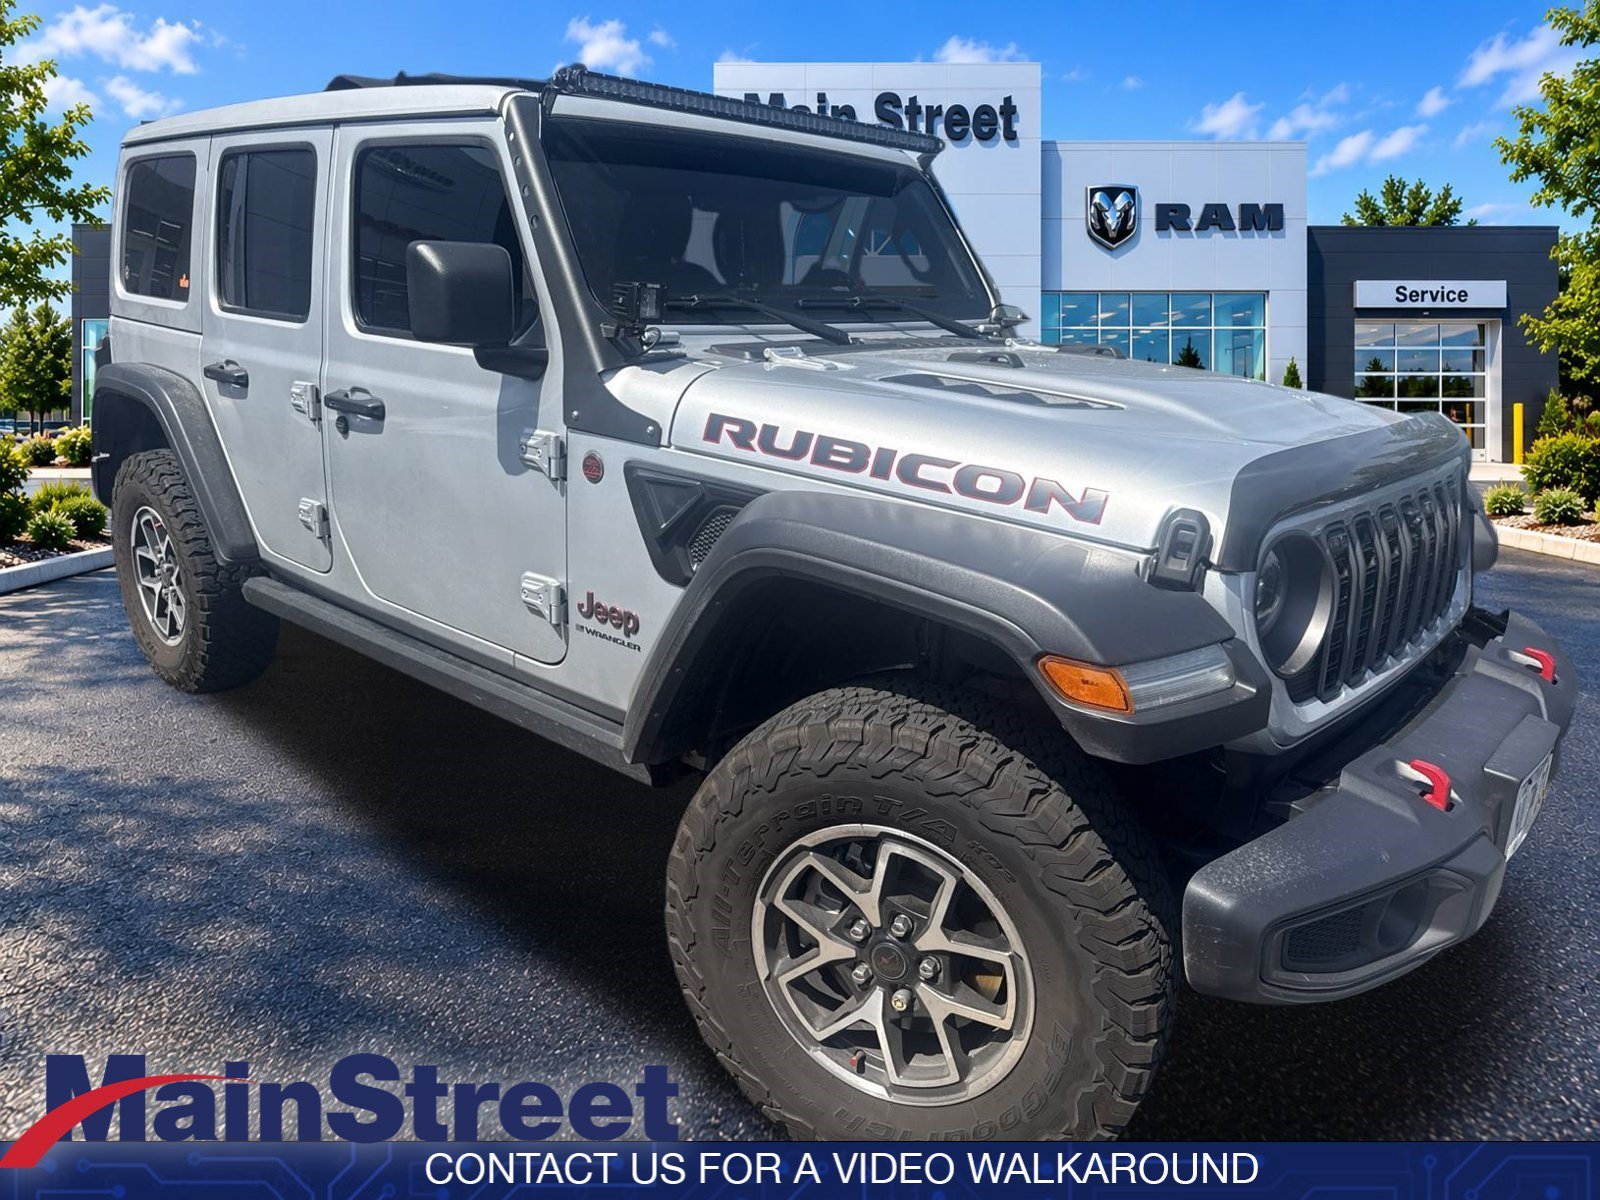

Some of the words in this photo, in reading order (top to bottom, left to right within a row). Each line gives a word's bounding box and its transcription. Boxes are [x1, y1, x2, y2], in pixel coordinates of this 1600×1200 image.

[873, 92, 1018, 141] Street
[1154, 203, 1285, 232] RAM
[1394, 285, 1469, 304] Service
[702, 412, 1109, 525] RUBICON
[577, 591, 640, 639] Jeep
[584, 626, 642, 652] WRANGLER
